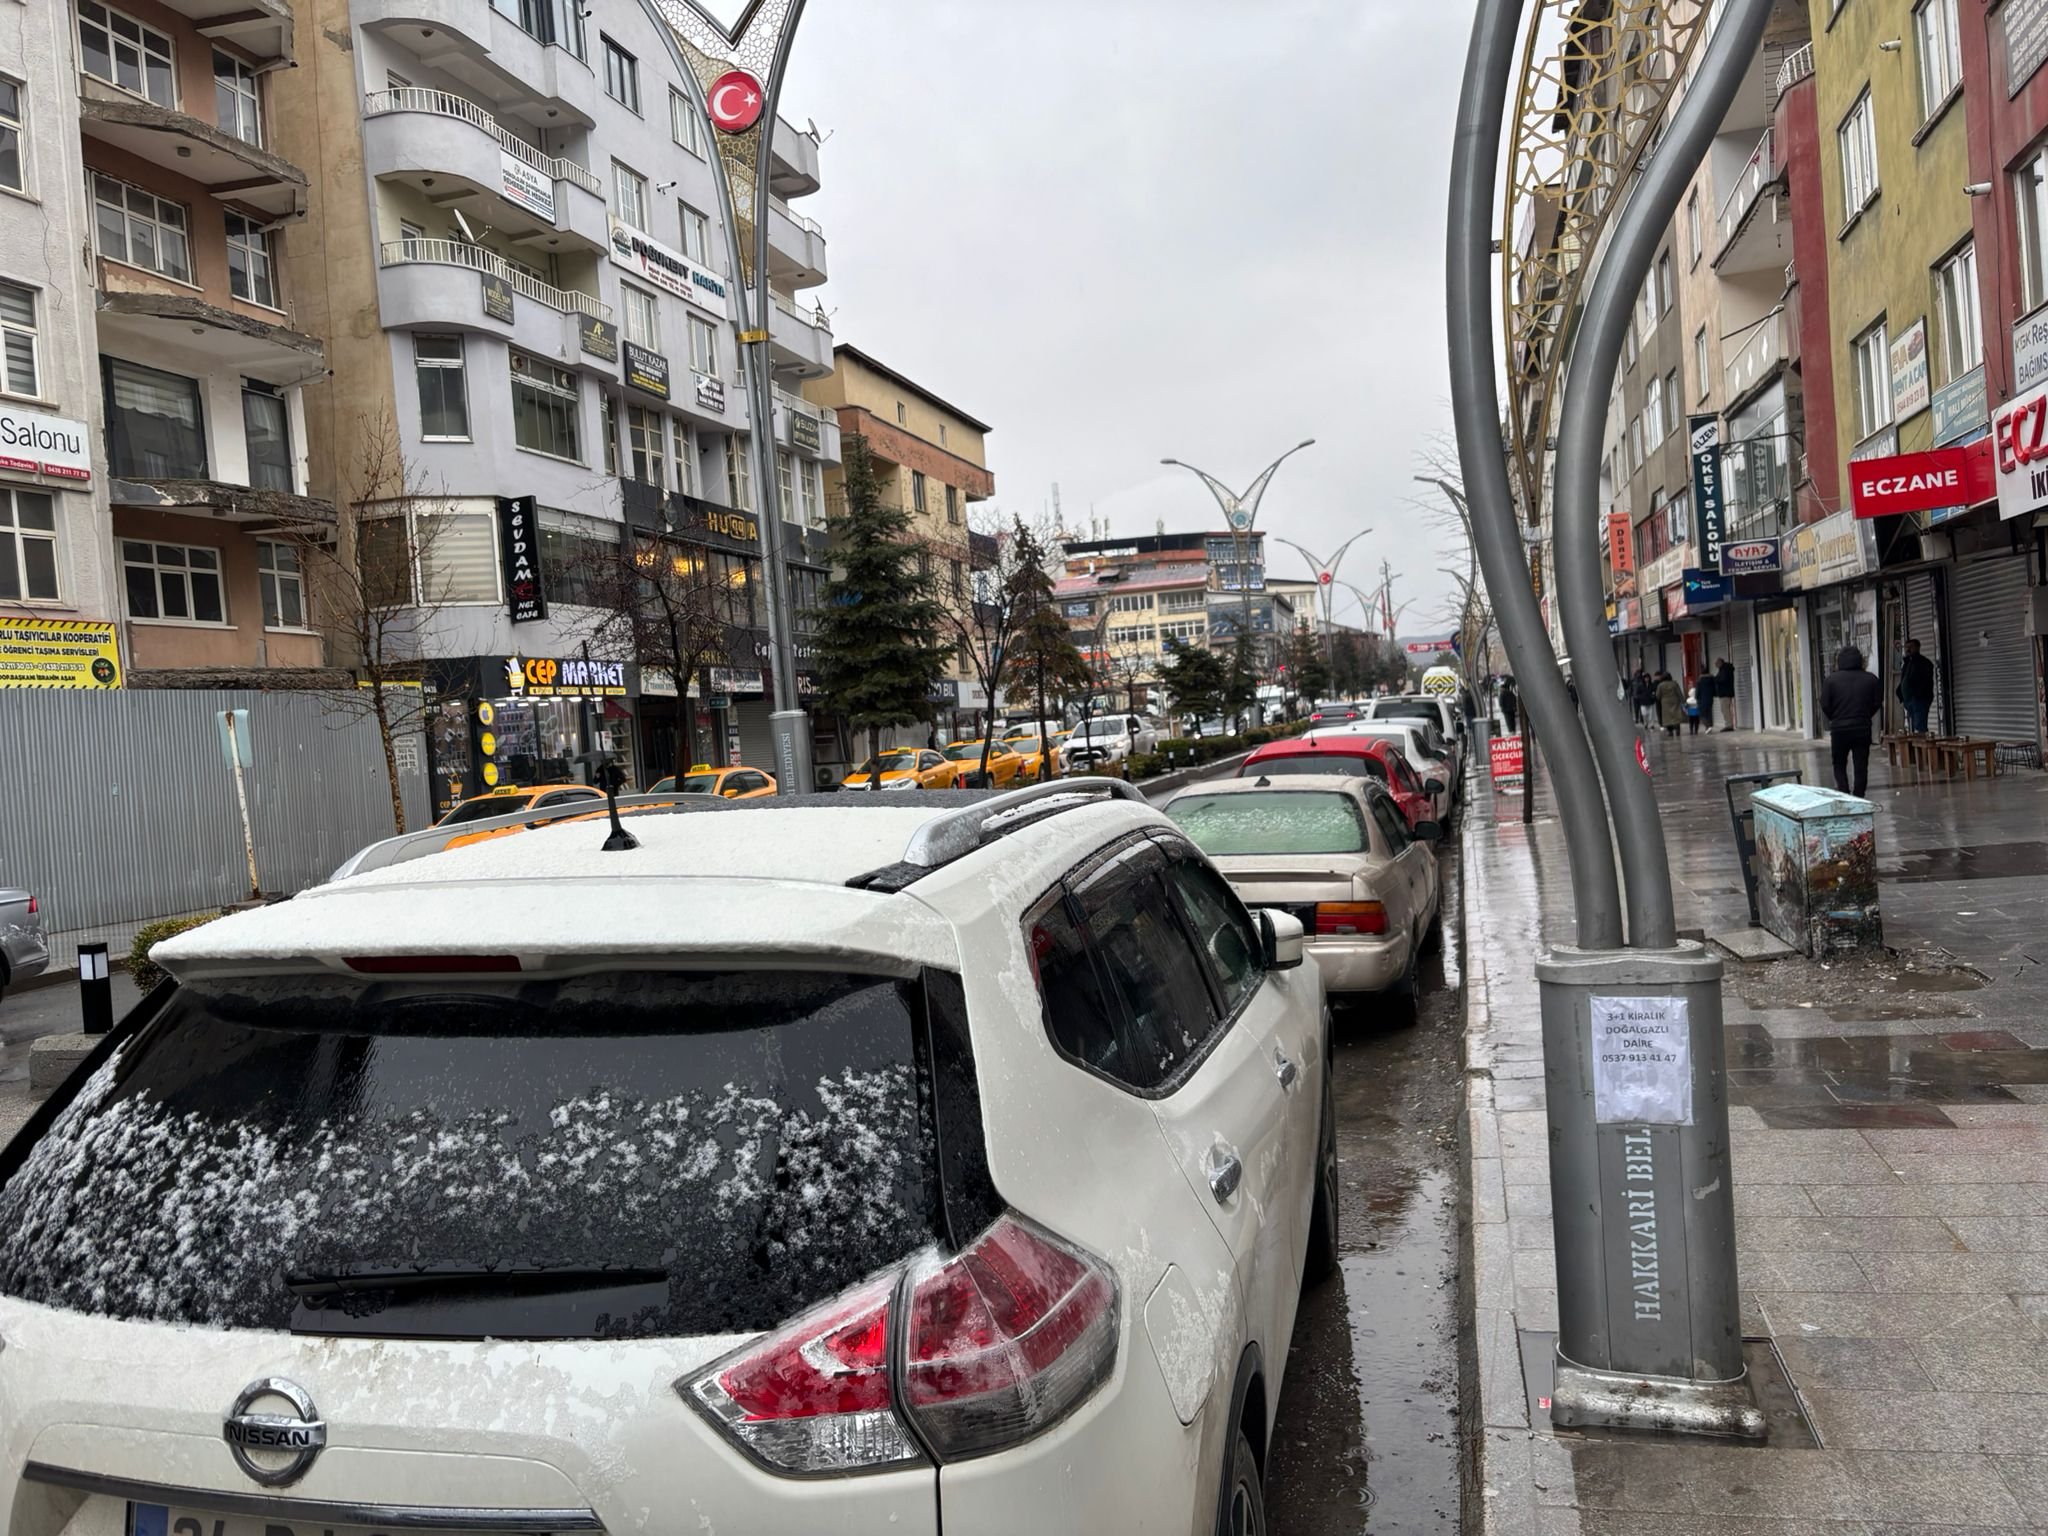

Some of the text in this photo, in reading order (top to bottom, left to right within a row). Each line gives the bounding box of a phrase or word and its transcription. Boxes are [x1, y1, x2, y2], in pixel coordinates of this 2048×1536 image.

[521, 170, 538, 185] ASYA
[631, 236, 689, 279] DOĞUKENT
[692, 270, 725, 298] HARİTA
[628, 346, 667, 371] BULUT KAZAK
[1, 417, 80, 454] Salonu
[1693, 426, 1717, 449] ELZEM
[1862, 469, 1958, 498] ECZANE
[1700, 454, 1720, 562] OKEY SALONU
[1734, 545, 1768, 557] AYAZ
[15, 630, 61, 643] TAŞIYICILAR
[63, 632, 111, 644] KOOPERATİFİ
[3, 645, 99, 657] ÖĞRENCİ TAŞIMA SERVİSLERİ
[526, 659, 557, 685] CEP
[562, 661, 625, 686] MARKET
[1491, 740, 1523, 751] KARMEN
[1607, 1011, 1666, 1021] 3+1 KİRALIK
[1606, 1024, 1669, 1035] DOĞALGAZLI
[1623, 1038, 1653, 1048] DAİRE
[1602, 1054, 1626, 1063] 0537
[1629, 1054, 1647, 1062] 913
[1650, 1054, 1661, 1062] 41
[1621, 1187, 1661, 1321] HAKKARİ
[228, 1425, 310, 1446] NISSAN
